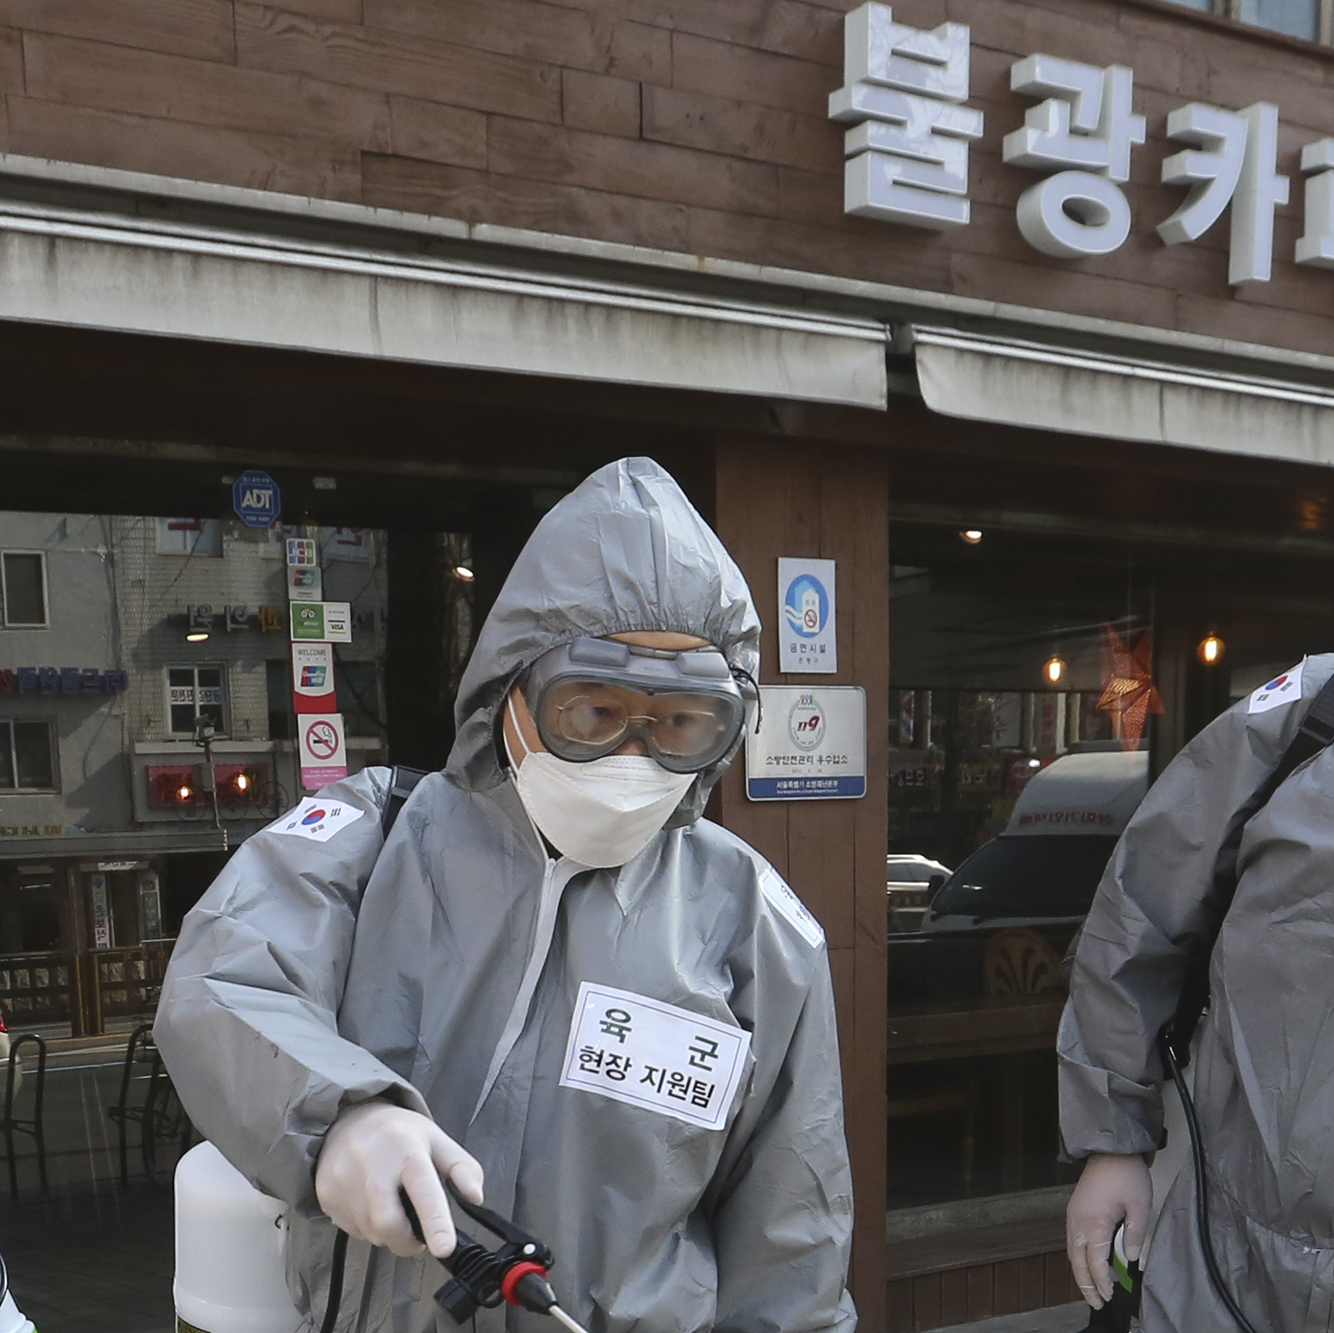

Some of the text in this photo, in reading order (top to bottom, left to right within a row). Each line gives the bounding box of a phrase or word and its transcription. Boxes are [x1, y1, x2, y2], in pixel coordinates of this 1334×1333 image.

[241, 489, 273, 508] ADT
[298, 649, 327, 657] WELCOME
[796, 715, 820, 731] 119
[599, 1008, 719, 1071] 육 군
[579, 1045, 717, 1109] 현장 지원팀
